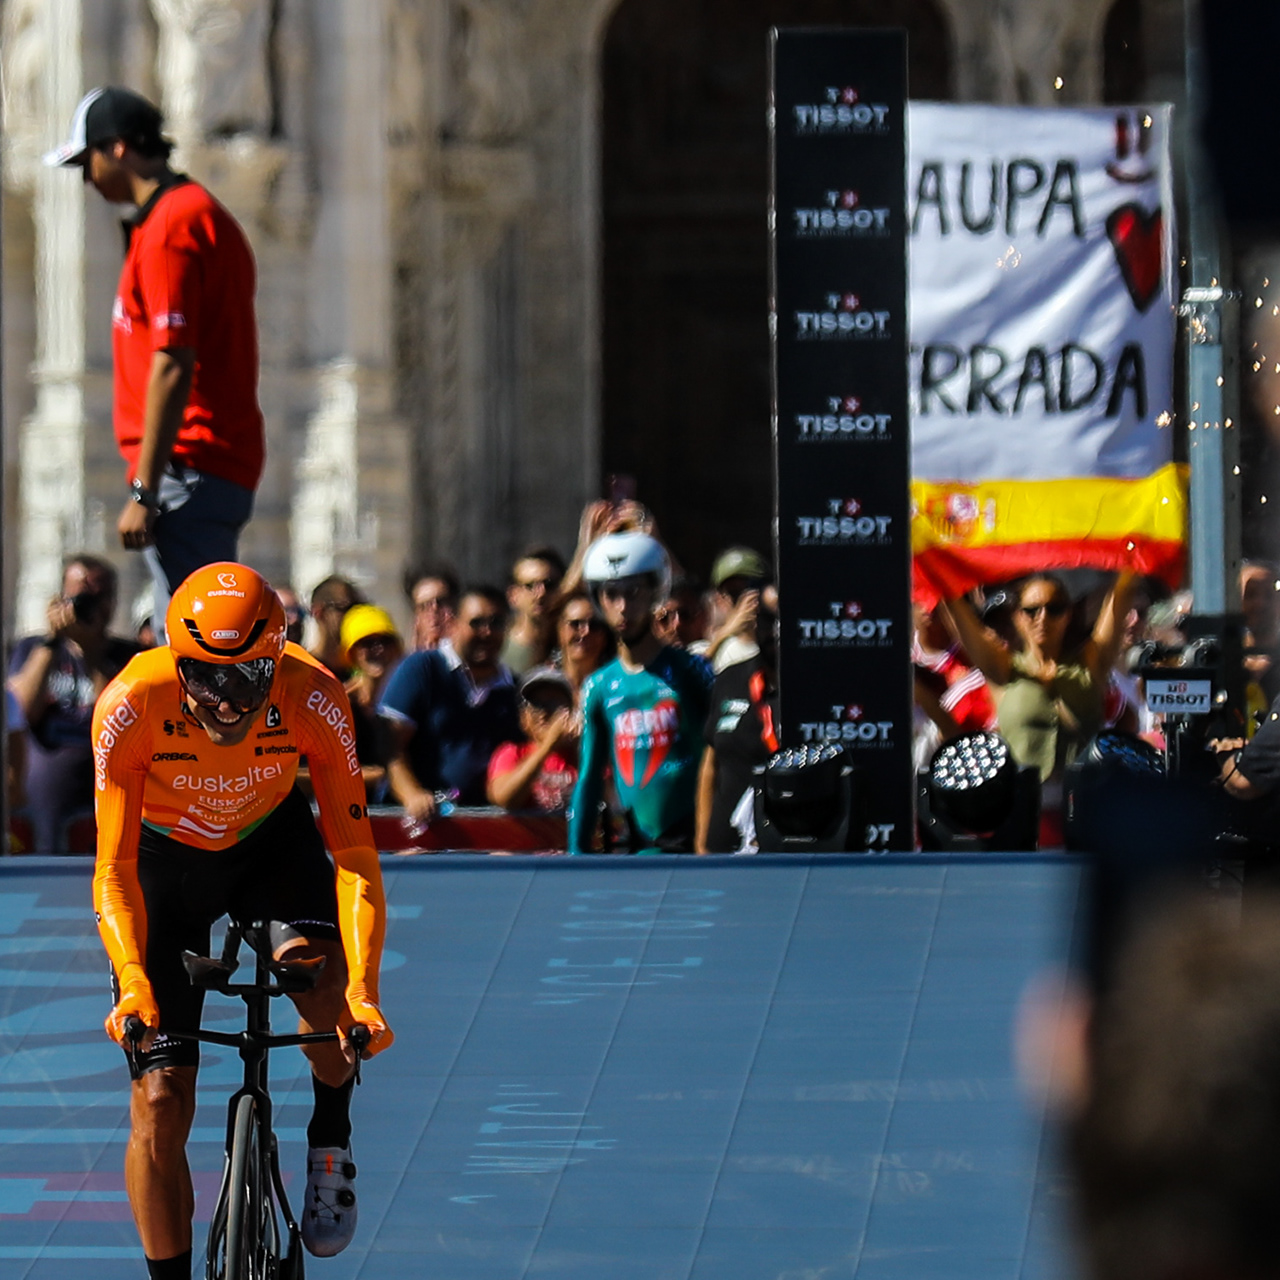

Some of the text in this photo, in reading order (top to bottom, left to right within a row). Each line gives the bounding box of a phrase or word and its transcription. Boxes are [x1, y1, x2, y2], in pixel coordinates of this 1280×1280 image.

[794, 104, 890, 127] TISSOT
[911, 159, 1086, 238] AUPA
[795, 208, 890, 229] TISSOT
[796, 311, 891, 332] TISSOT
[910, 344, 1150, 422] RRADA
[798, 414, 892, 433] TISSOT
[798, 517, 893, 537] TISSOT
[208, 589, 245, 598] euskaltel
[799, 620, 893, 639] TISSOT
[1150, 694, 1209, 705] TISSOT
[307, 690, 360, 776] euskaltel
[800, 721, 894, 743] TISSOT
[95, 697, 138, 791] euskaltel
[152, 752, 199, 762] ORBEA
[172, 762, 282, 793] euskaltel
